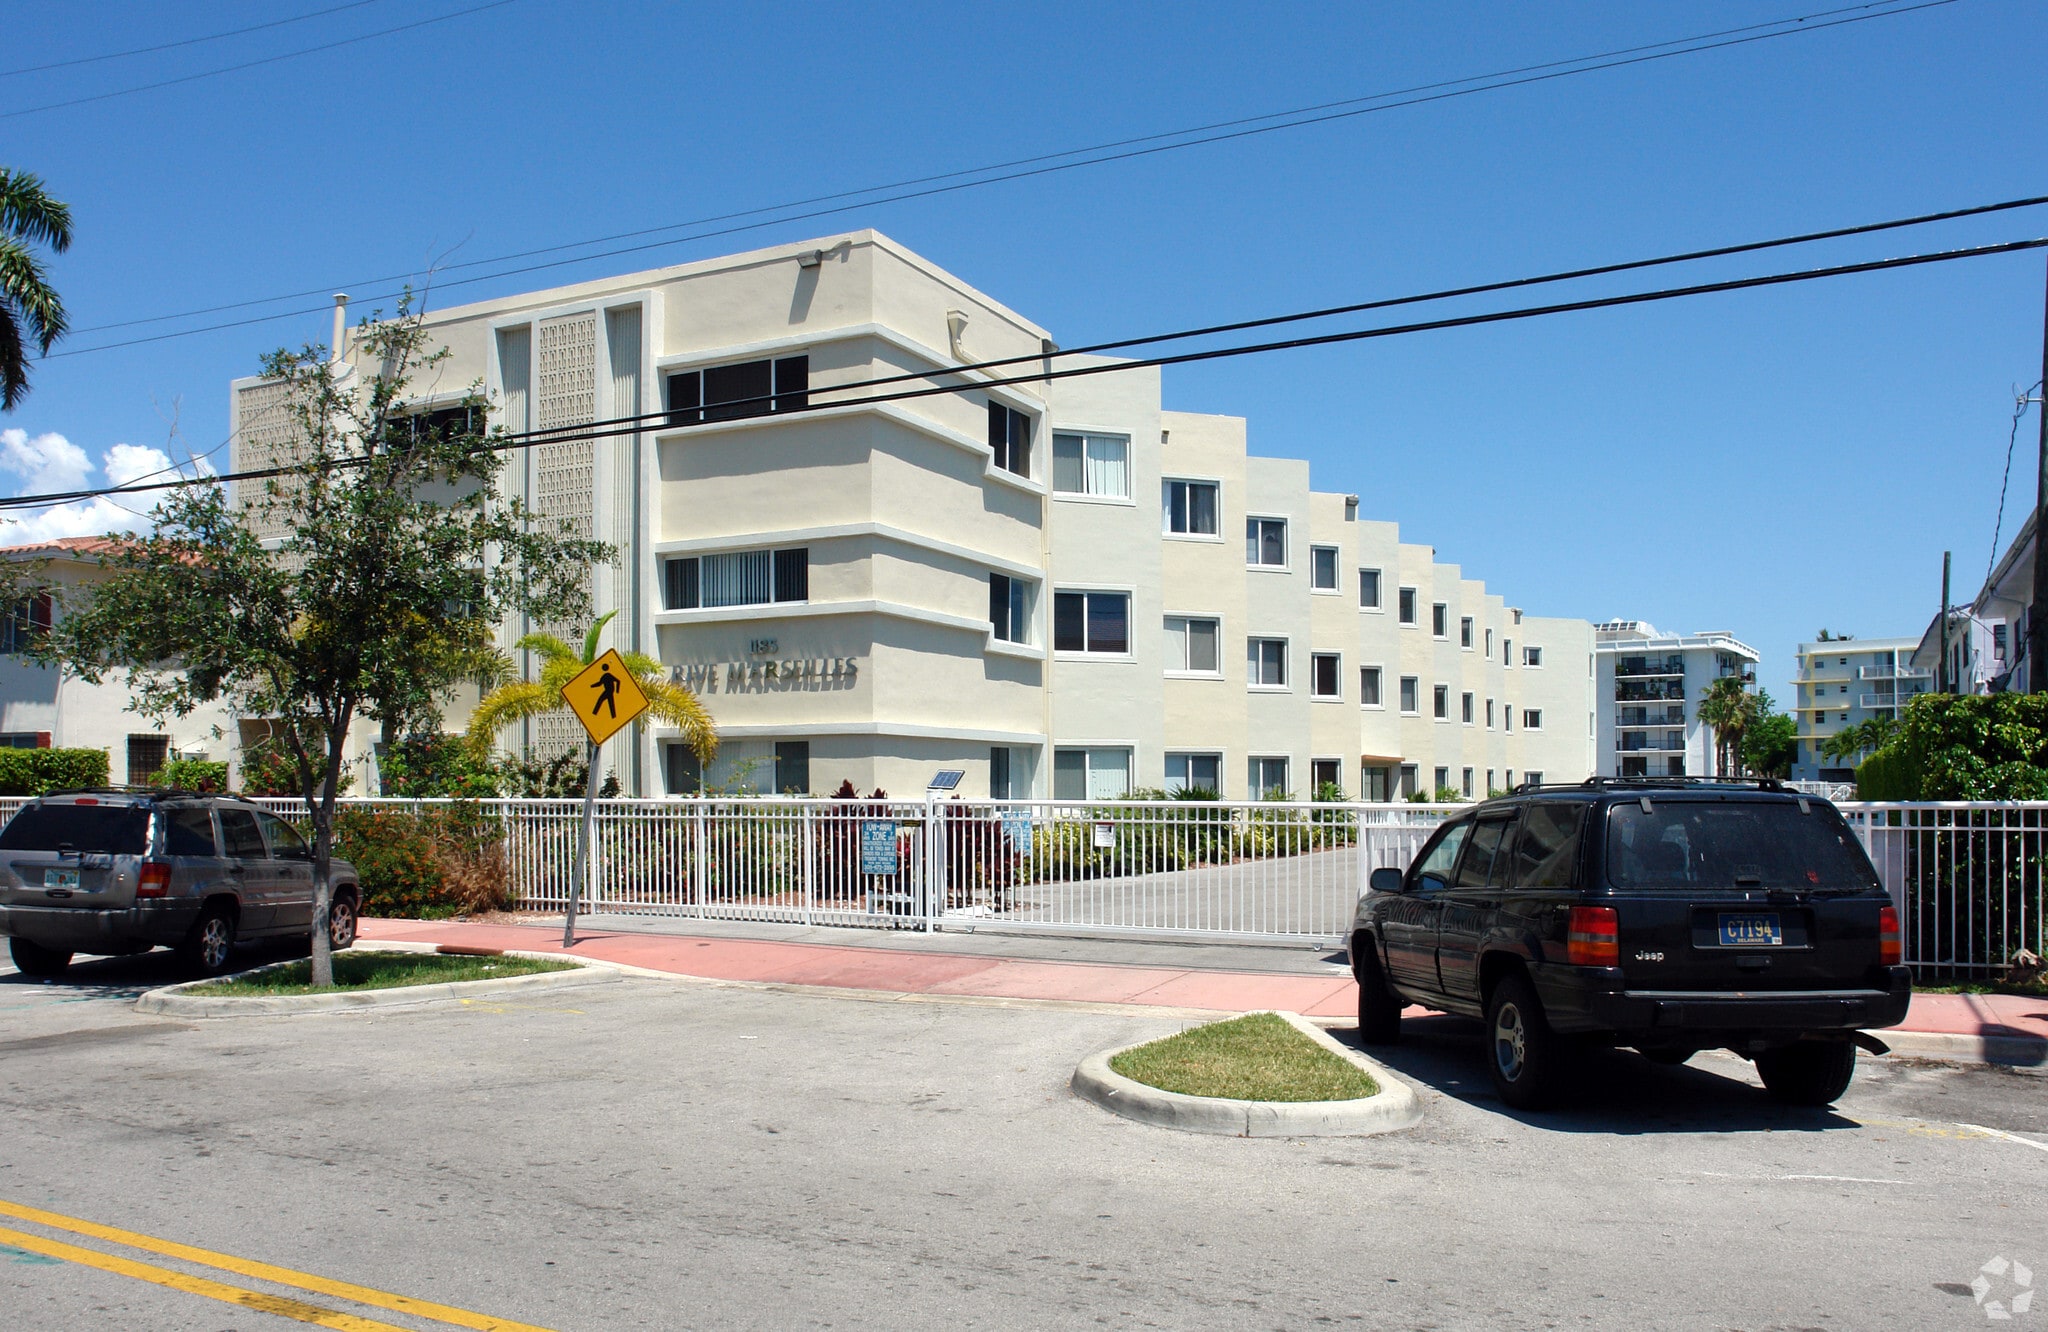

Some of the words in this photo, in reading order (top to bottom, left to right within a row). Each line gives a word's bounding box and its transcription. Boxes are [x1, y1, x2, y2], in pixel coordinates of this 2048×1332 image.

[671, 663, 718, 684] RIVE
[727, 657, 858, 682] MARSEILLES
[872, 831, 887, 841] ZONE
[1727, 920, 1773, 938] C7194
[1635, 950, 1665, 962] Jeep
